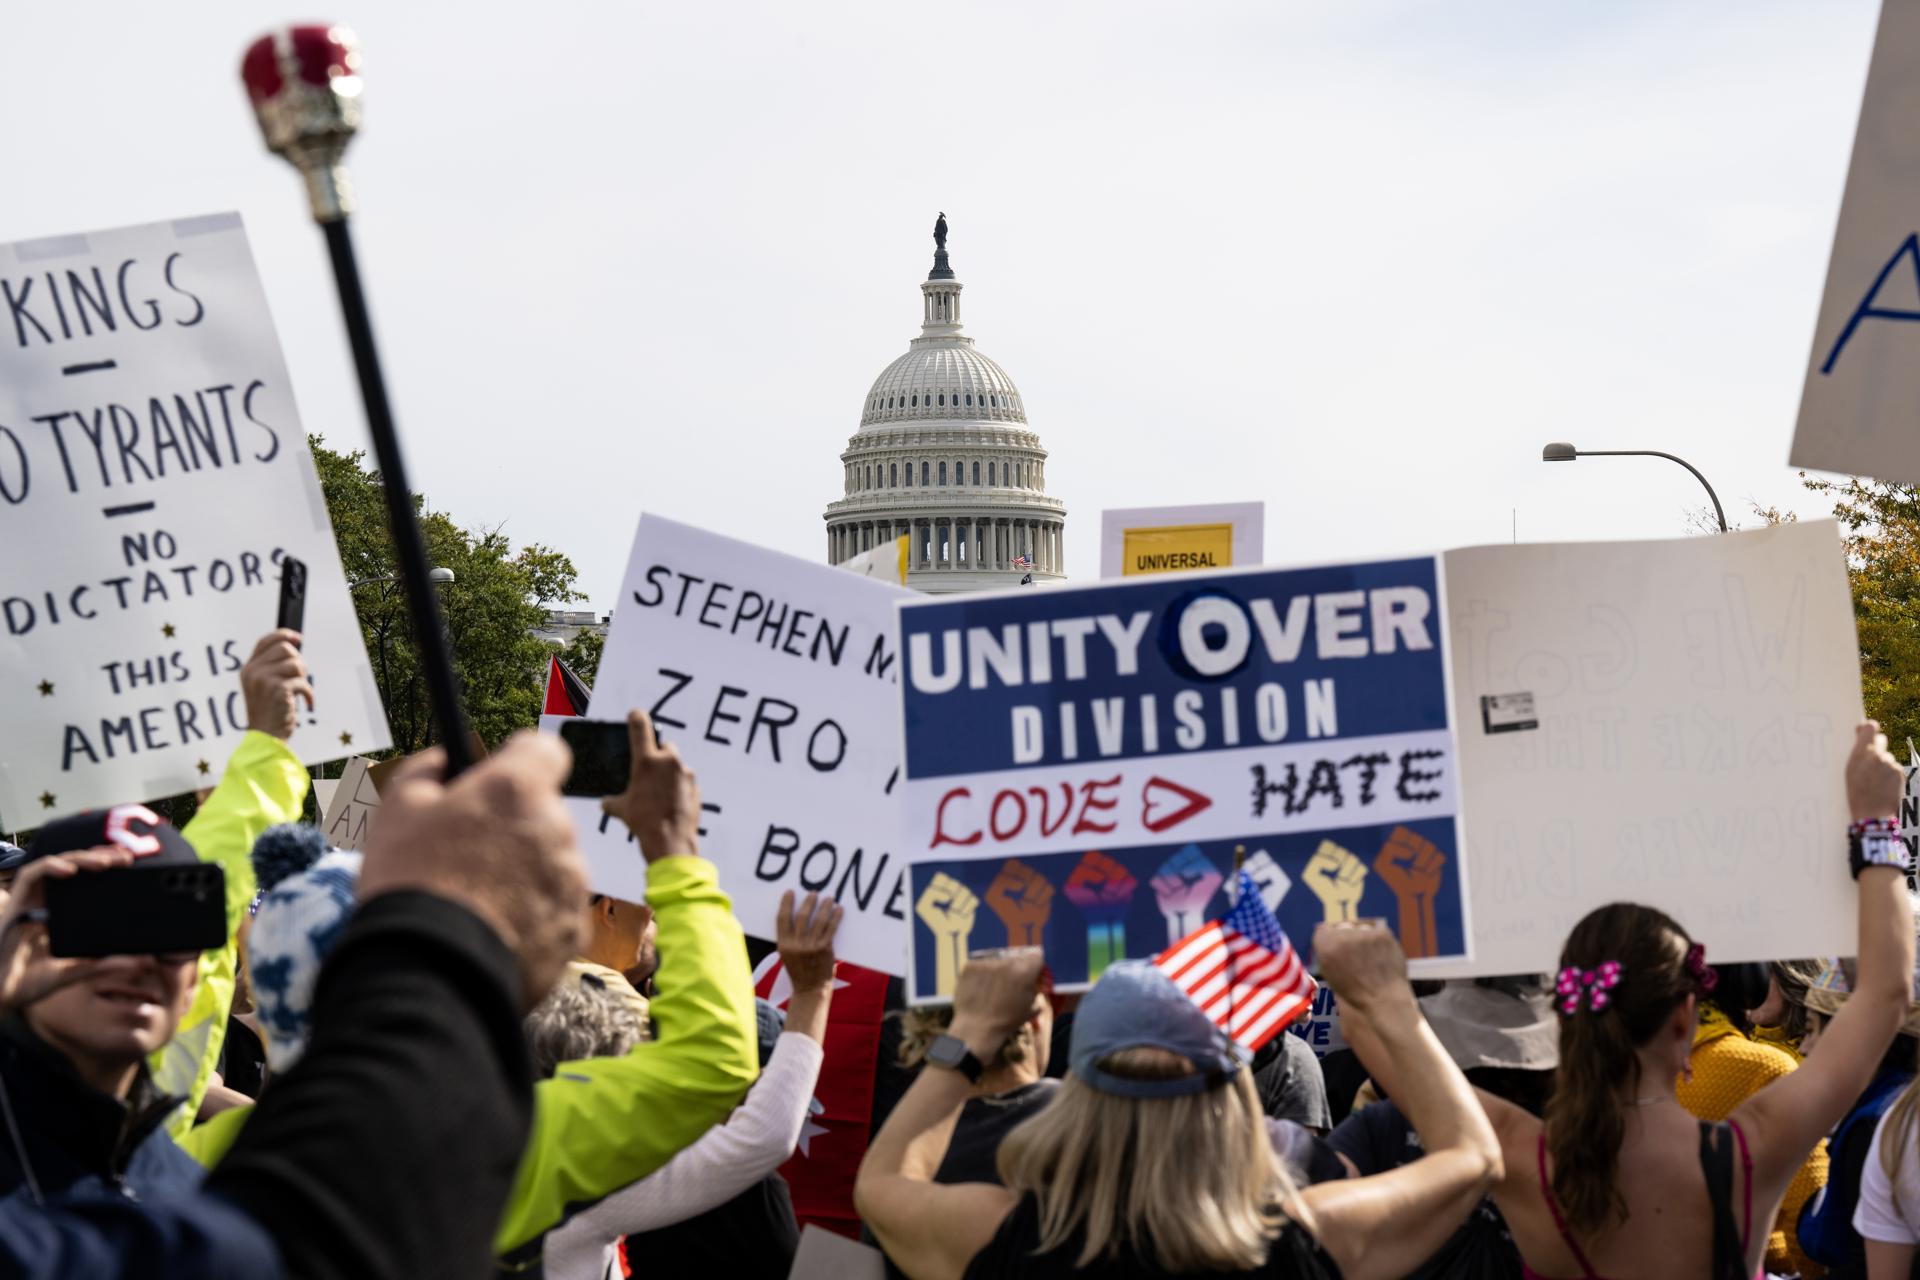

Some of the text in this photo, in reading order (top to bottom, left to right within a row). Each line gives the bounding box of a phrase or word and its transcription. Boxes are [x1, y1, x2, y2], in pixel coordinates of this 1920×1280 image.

[1, 251, 205, 347] KINGS
[30, 379, 280, 493] TYRANTS
[121, 530, 178, 568] NO
[1137, 552, 1217, 571] UNIVERSAL
[633, 564, 851, 667] STEPHEN
[909, 586, 1434, 694] UNITY OVER
[100, 640, 243, 695] THIS IS
[649, 667, 850, 773] ZERO
[1011, 678, 1339, 765] DIVISION
[106, 802, 164, 858] C
[930, 774, 1123, 850] LOVE
[1249, 748, 1446, 818] HATE
